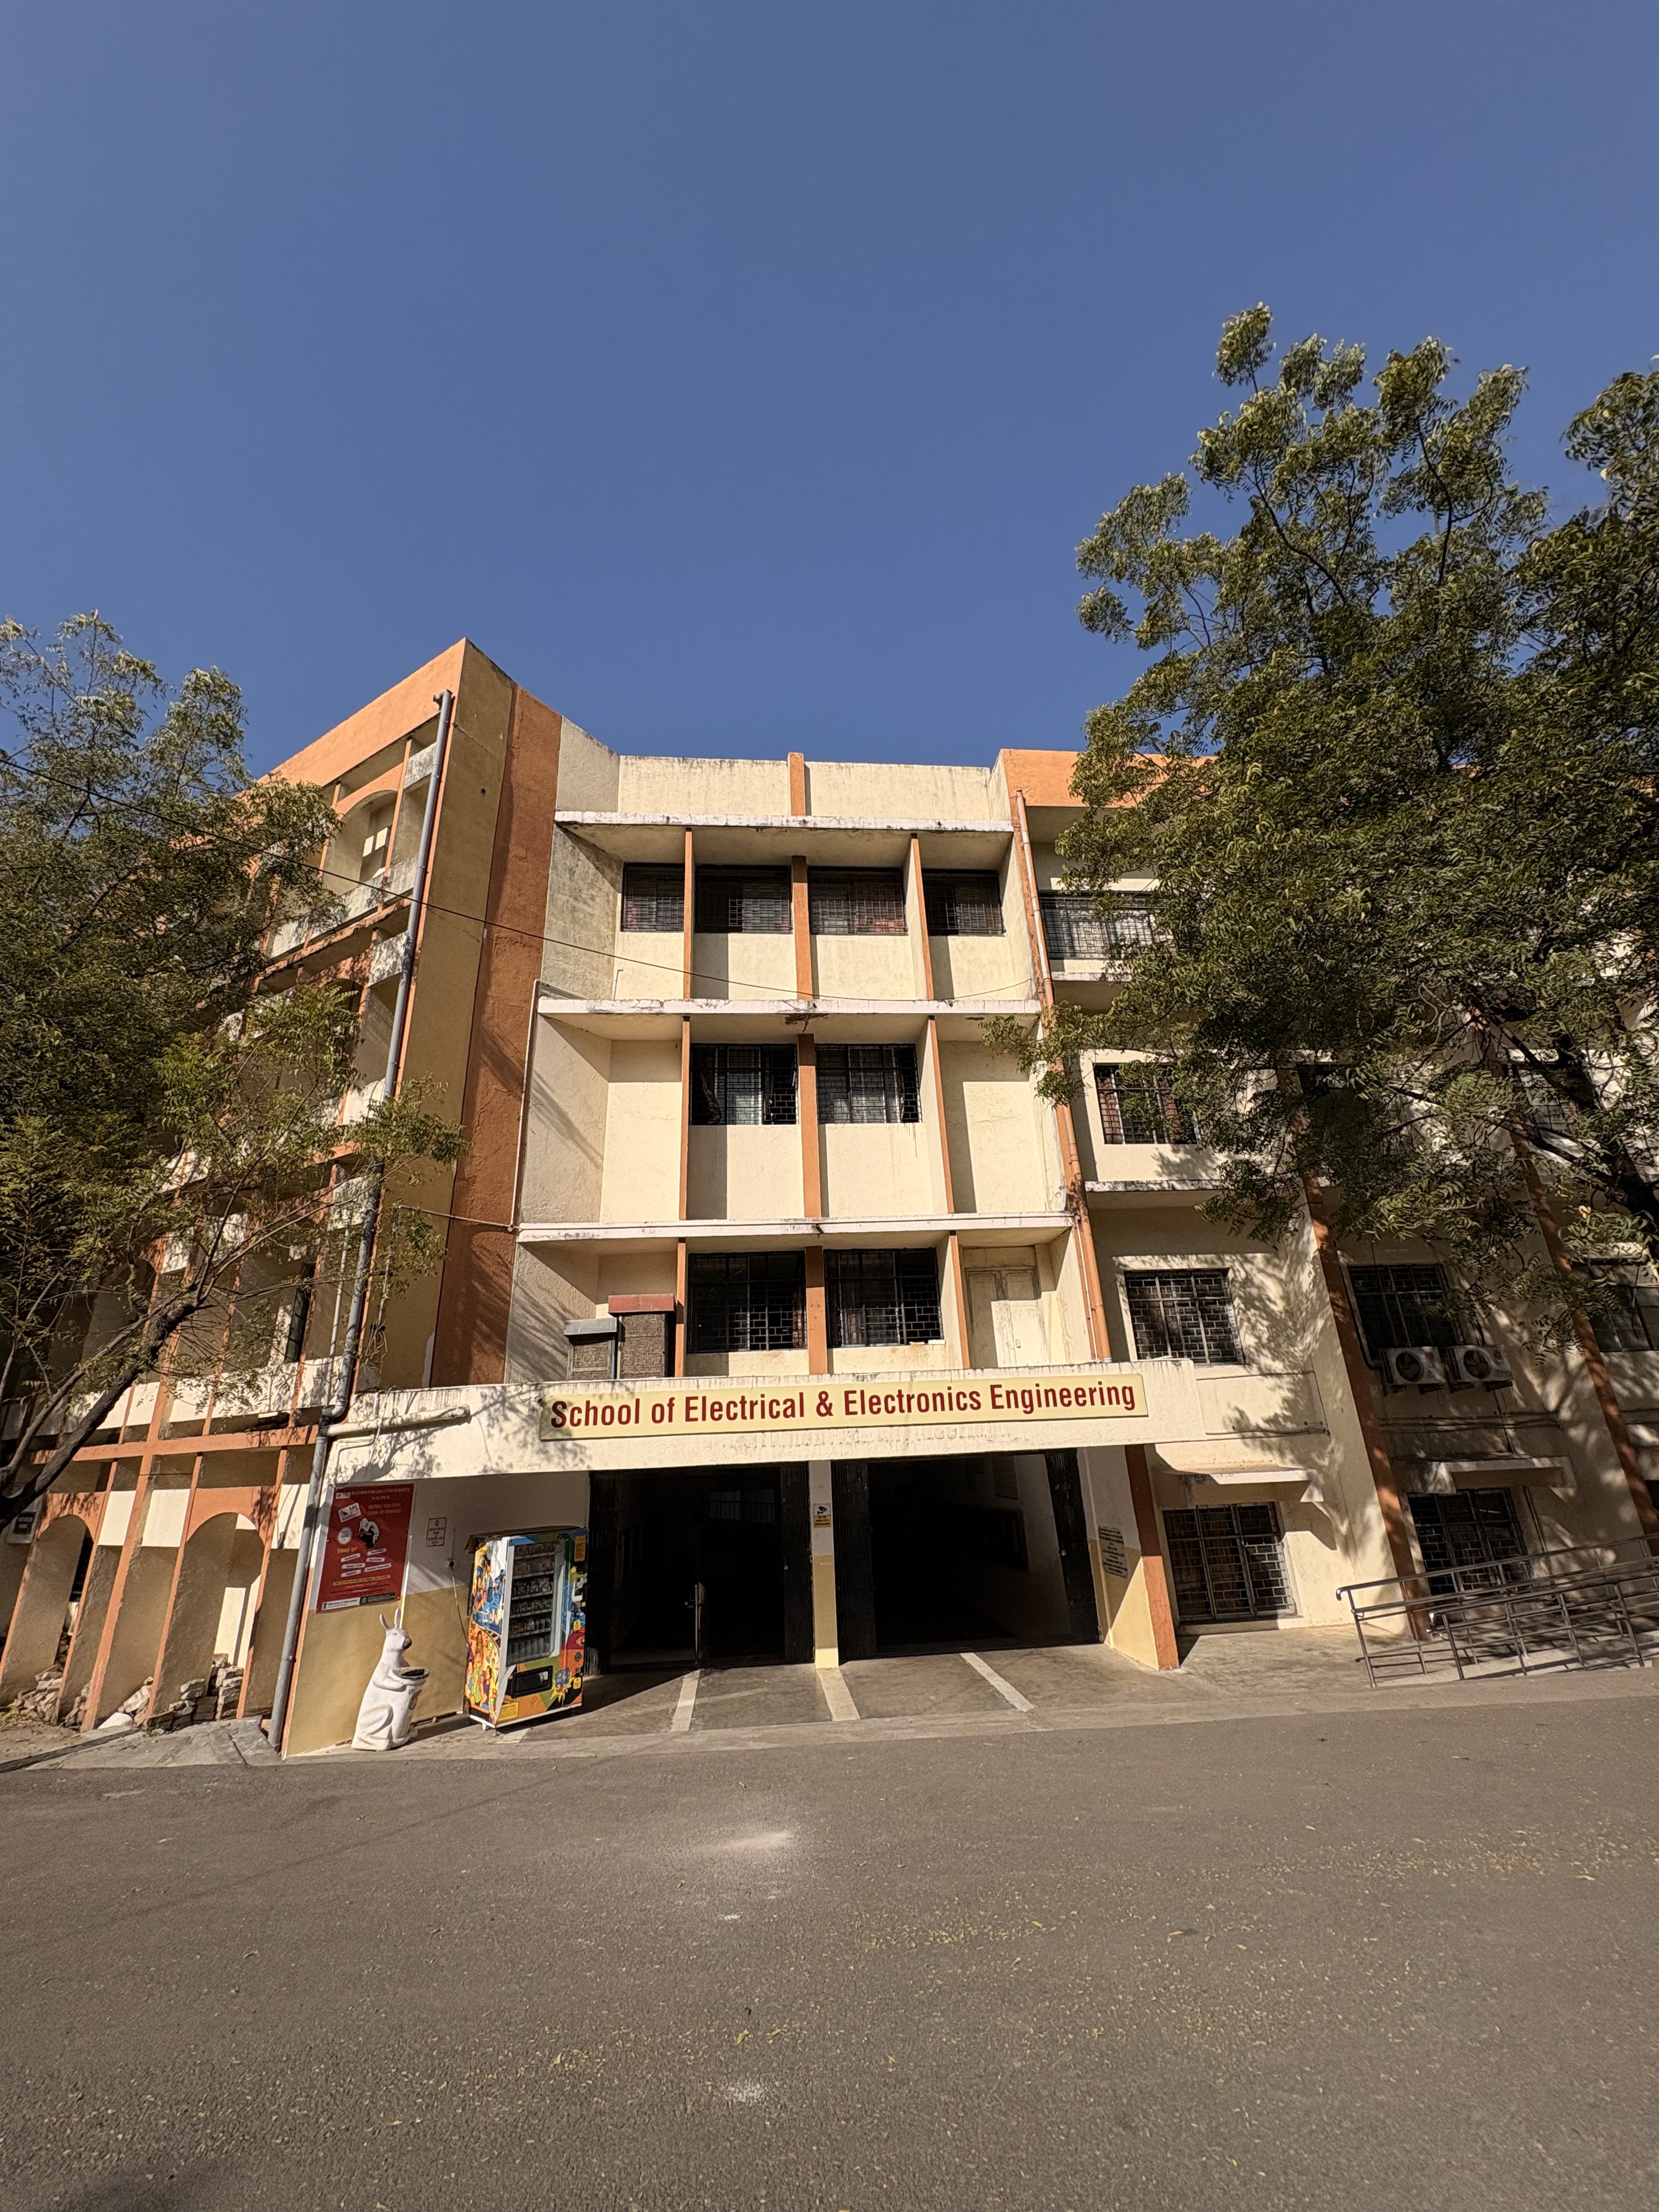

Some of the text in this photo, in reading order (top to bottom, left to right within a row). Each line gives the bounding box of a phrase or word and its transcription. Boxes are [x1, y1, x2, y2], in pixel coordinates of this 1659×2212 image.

[550, 1381, 1136, 1427] School of Electrical & Electronics Engineering
